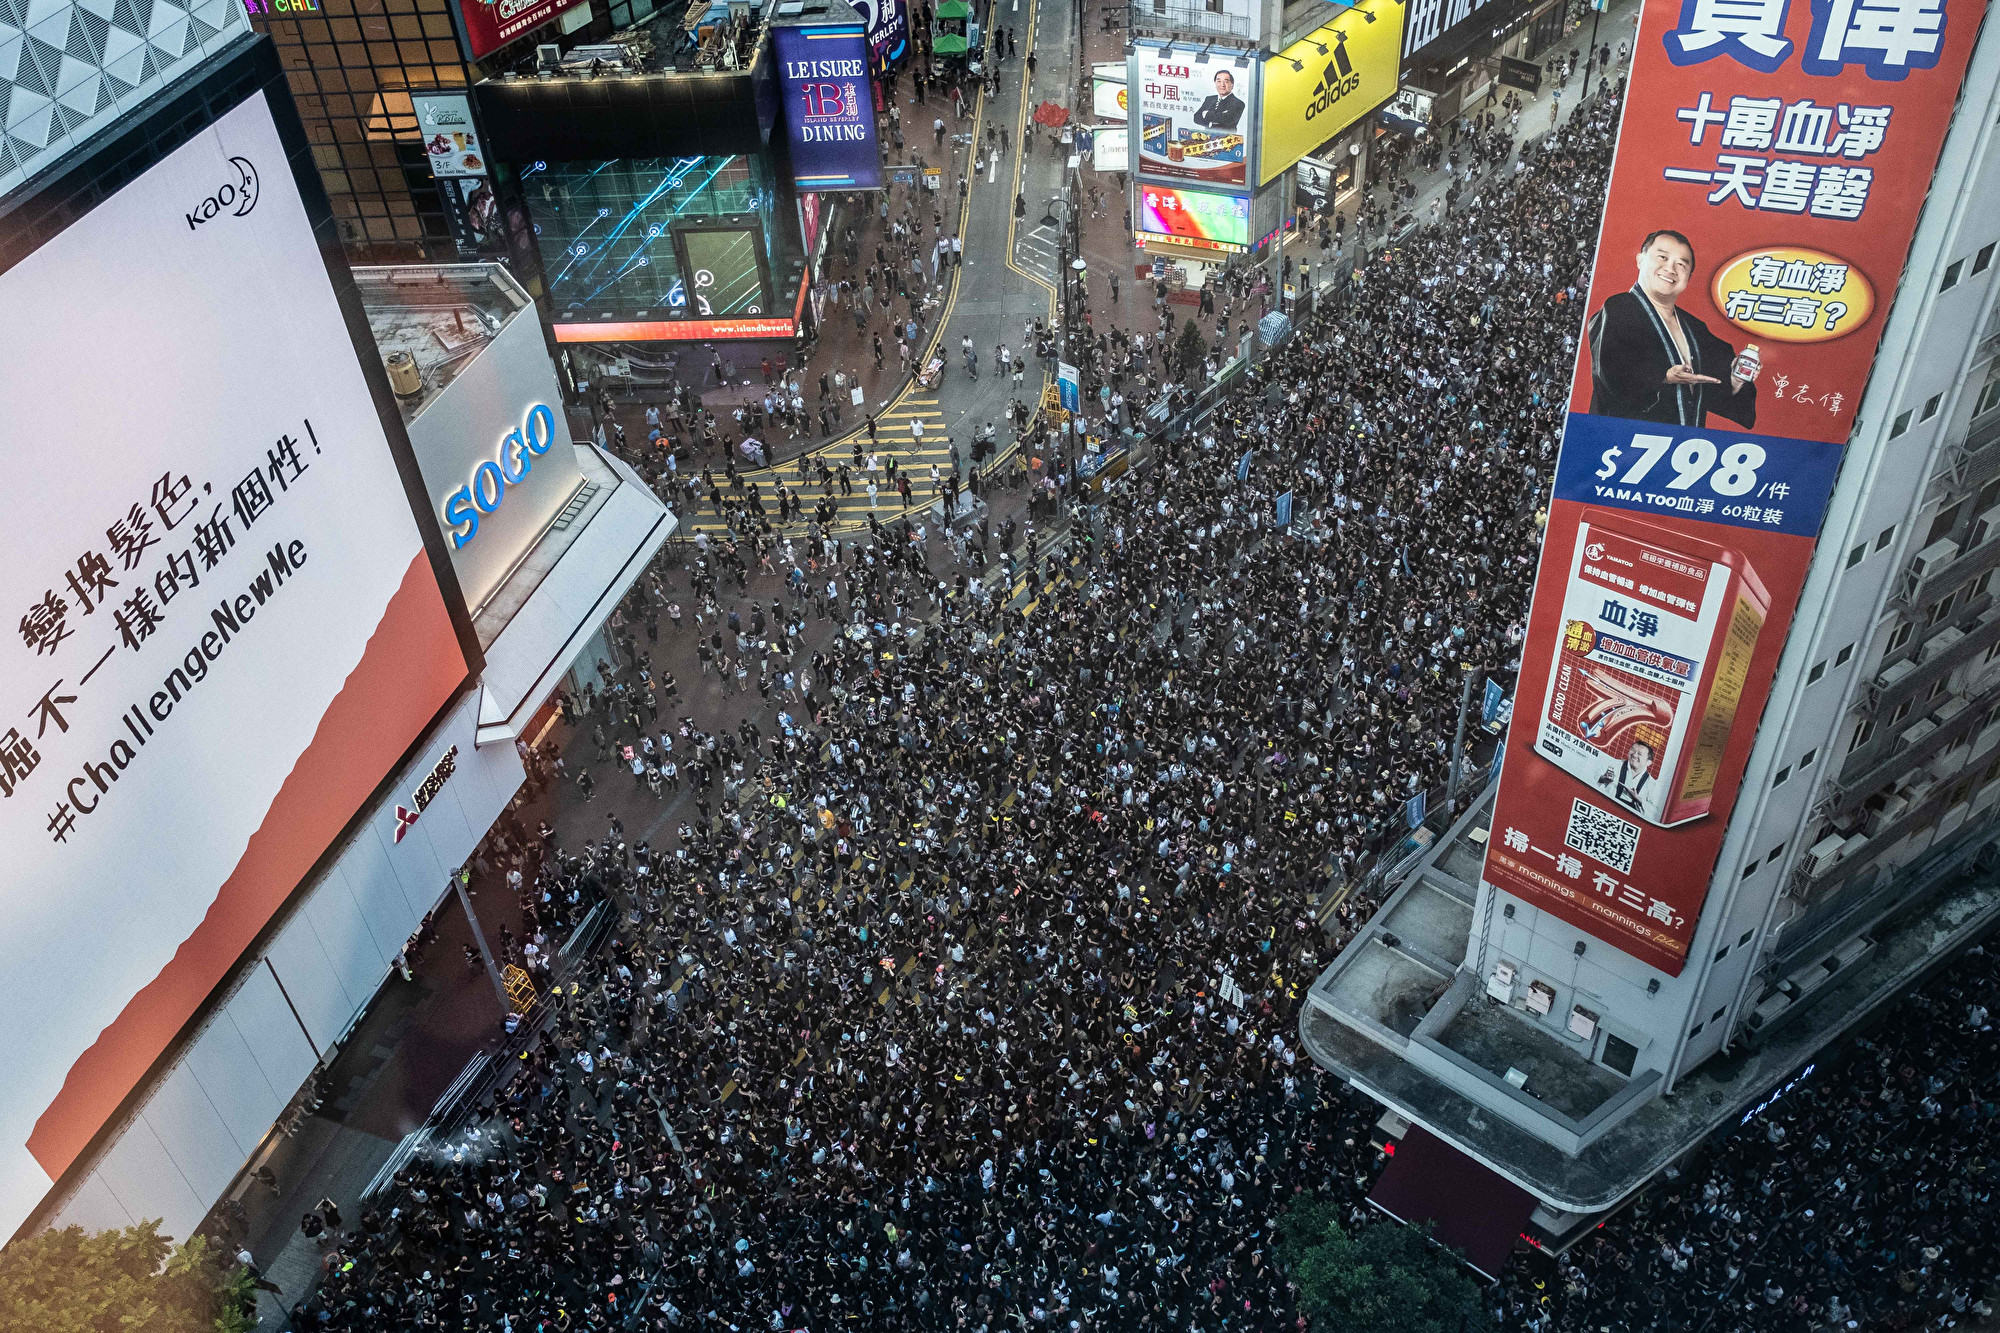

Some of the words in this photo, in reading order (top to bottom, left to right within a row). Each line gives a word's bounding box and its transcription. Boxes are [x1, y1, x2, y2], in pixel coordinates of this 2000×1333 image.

[787, 59, 864, 79] LEISURE
[1145, 82, 1181, 101] 中風
[1305, 73, 1360, 121] adidas
[802, 124, 865, 143] DINING
[186, 183, 236, 230] Kao
[1664, 154, 1873, 221] 一天售罄
[1749, 255, 1848, 294] 有血淨
[445, 403, 555, 550] SOGO
[1721, 504, 1784, 526] 60粒裝
[1606, 554, 1634, 567] YAMATOO
[1598, 599, 1660, 638] 血淨
[46, 537, 308, 844] #ChallengeNewMe
[1557, 664, 1572, 693] CLEAN
[1552, 692, 1567, 721] BLOOD
[1504, 826, 1583, 880] 掃一掃
[1519, 863, 1576, 900] mannings
[1592, 899, 1652, 938] mannings
